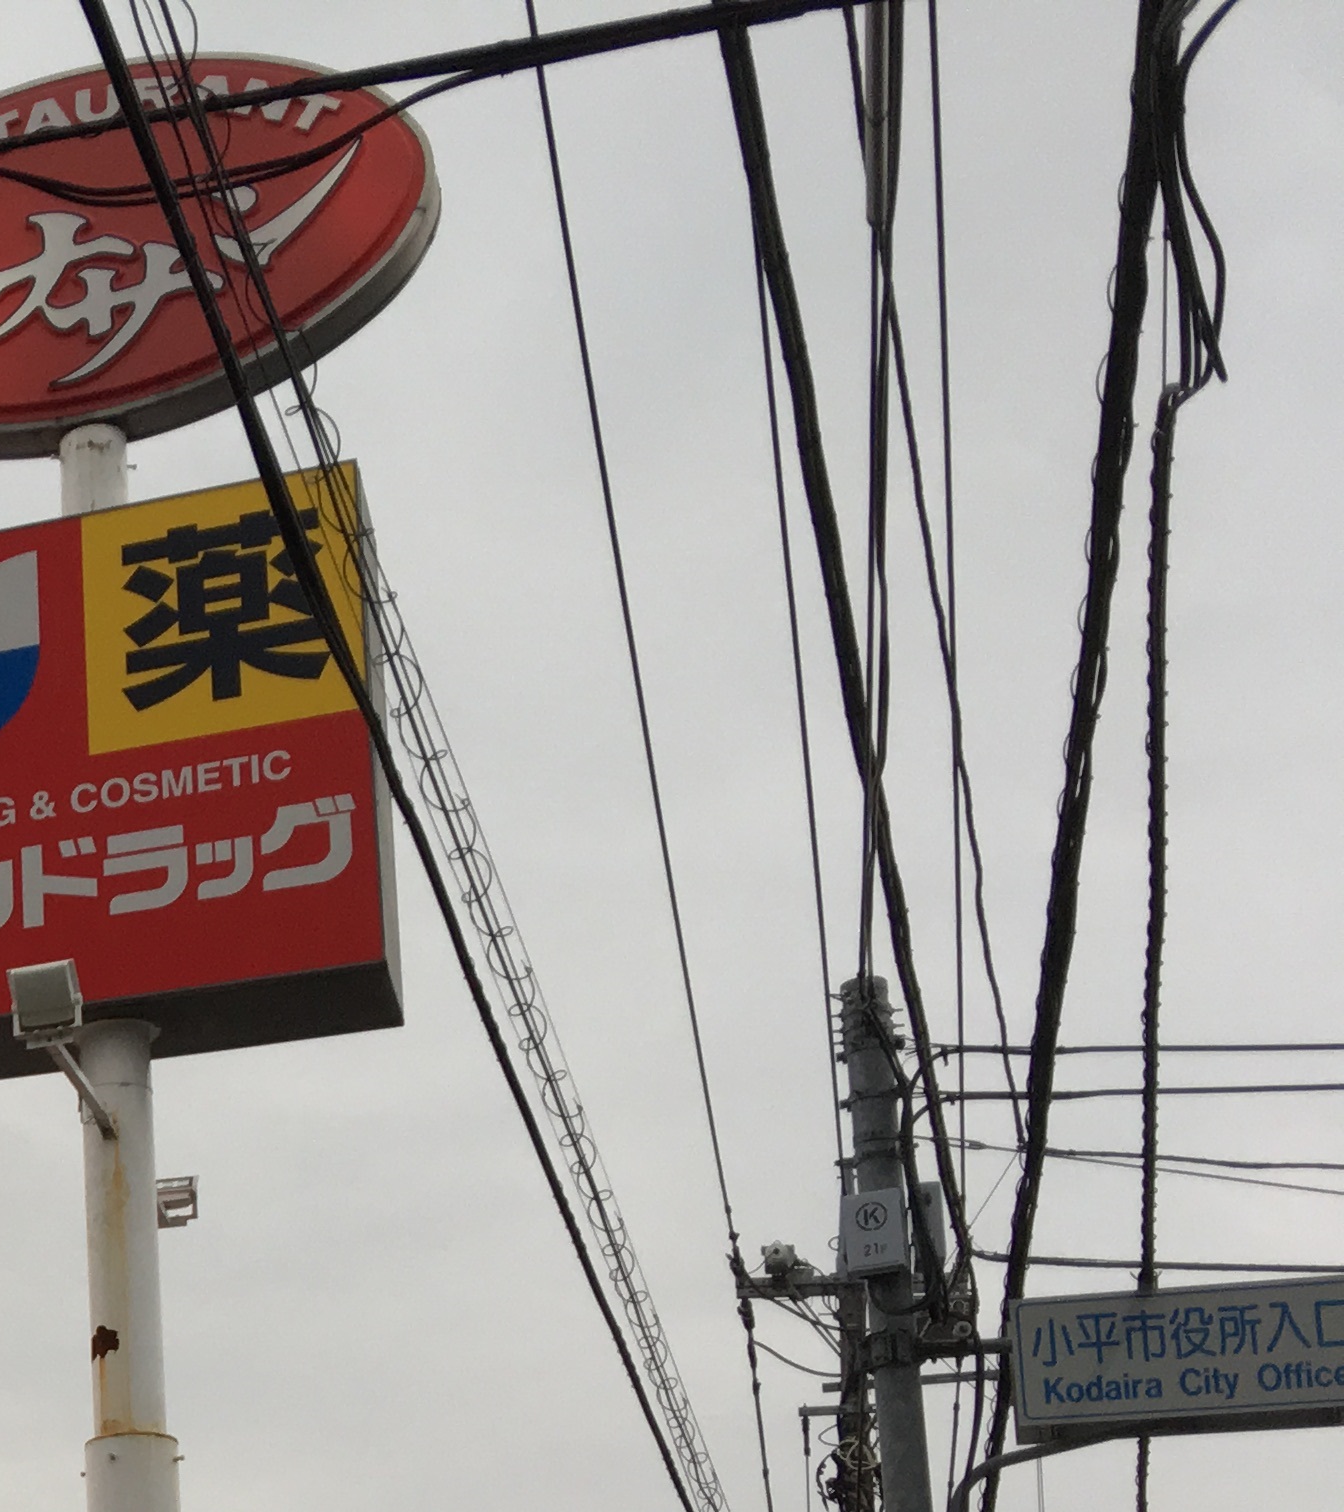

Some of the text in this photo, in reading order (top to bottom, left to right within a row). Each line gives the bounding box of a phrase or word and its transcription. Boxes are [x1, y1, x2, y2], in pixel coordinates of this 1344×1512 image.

[122, 508, 332, 712] 薬
[30, 790, 57, 820] &
[70, 750, 292, 814] COSMETIC
[1032, 1300, 1344, 1367] 小平市役所入口
[1043, 1373, 1163, 1405] Kodaira
[1179, 1366, 1240, 1400] City
